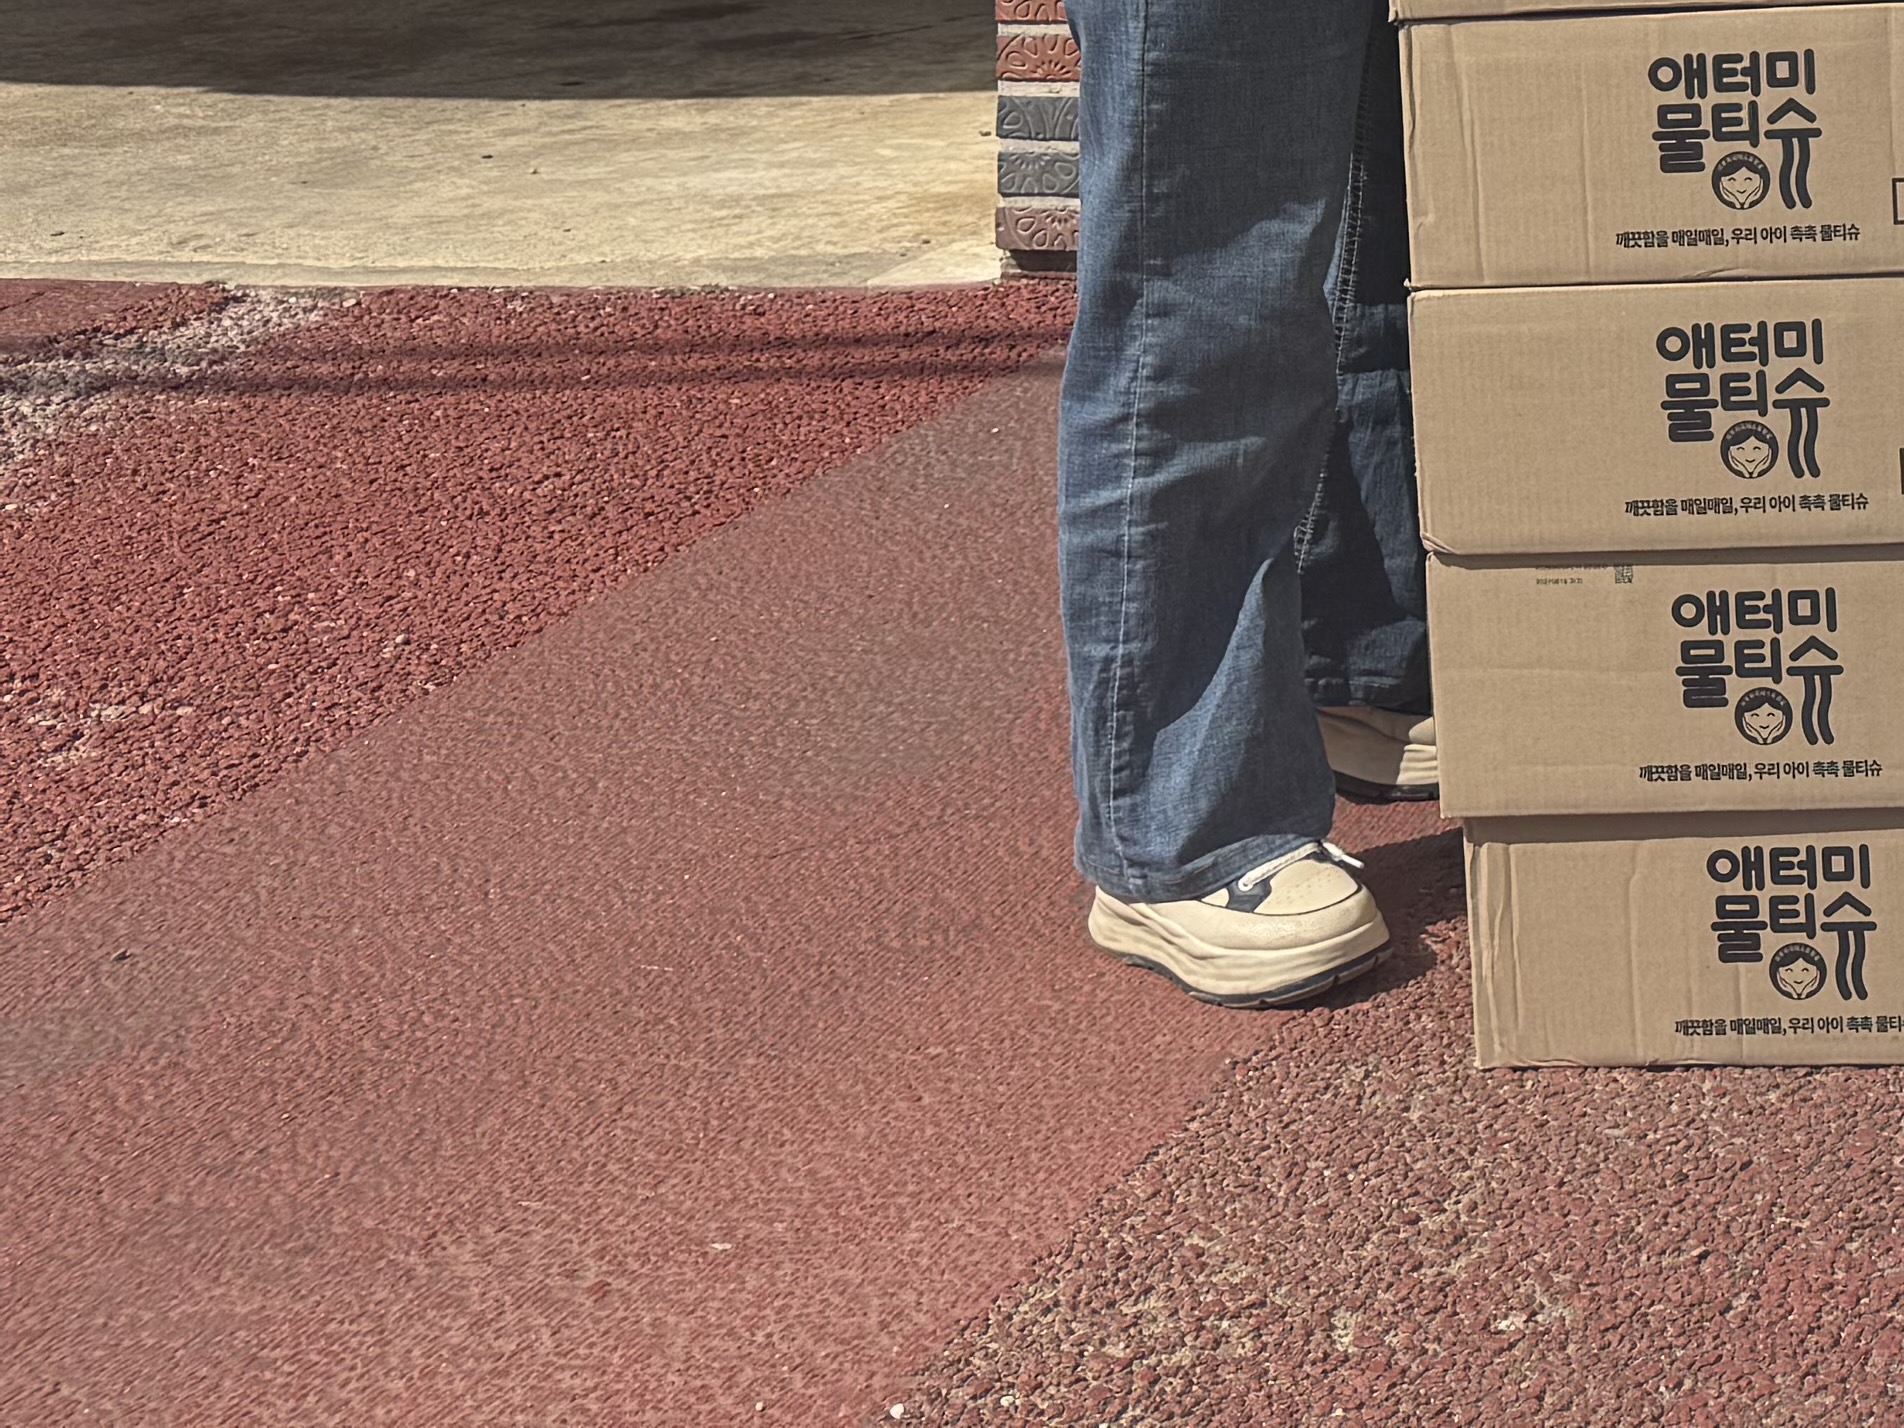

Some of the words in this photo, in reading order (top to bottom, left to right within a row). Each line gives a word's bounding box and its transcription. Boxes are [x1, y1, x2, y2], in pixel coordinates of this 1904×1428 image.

[1648, 48, 1817, 99] 애터미
[1651, 98, 1822, 210] 물티슈
[1672, 228, 1729, 247] 매일매일,
[1731, 227, 1757, 244] 우리
[1761, 226, 1787, 243] 아이
[1820, 223, 1860, 242] 물티슈
[1656, 318, 1824, 369] 애터미
[1660, 368, 1831, 480] 물티슈
[1681, 497, 1738, 515] 매일매일,
[1740, 496, 1765, 513] 우리
[1770, 495, 1795, 512] 아이
[1829, 493, 1869, 510] 물티슈
[1671, 586, 1838, 637] 애터미
[1675, 636, 1844, 746] 물티슈
[1695, 762, 1752, 781] 매일매일,
[1754, 762, 1780, 779] 우리
[1784, 761, 1809, 778] 아이
[1842, 759, 1882, 776] 물티슈
[1706, 843, 1871, 892] 애터미
[1710, 891, 1878, 1002] 물티슈
[1730, 1017, 1787, 1036] 매일매일,
[1788, 1017, 1814, 1034] 우리
[1818, 1016, 1843, 1033] 아이
